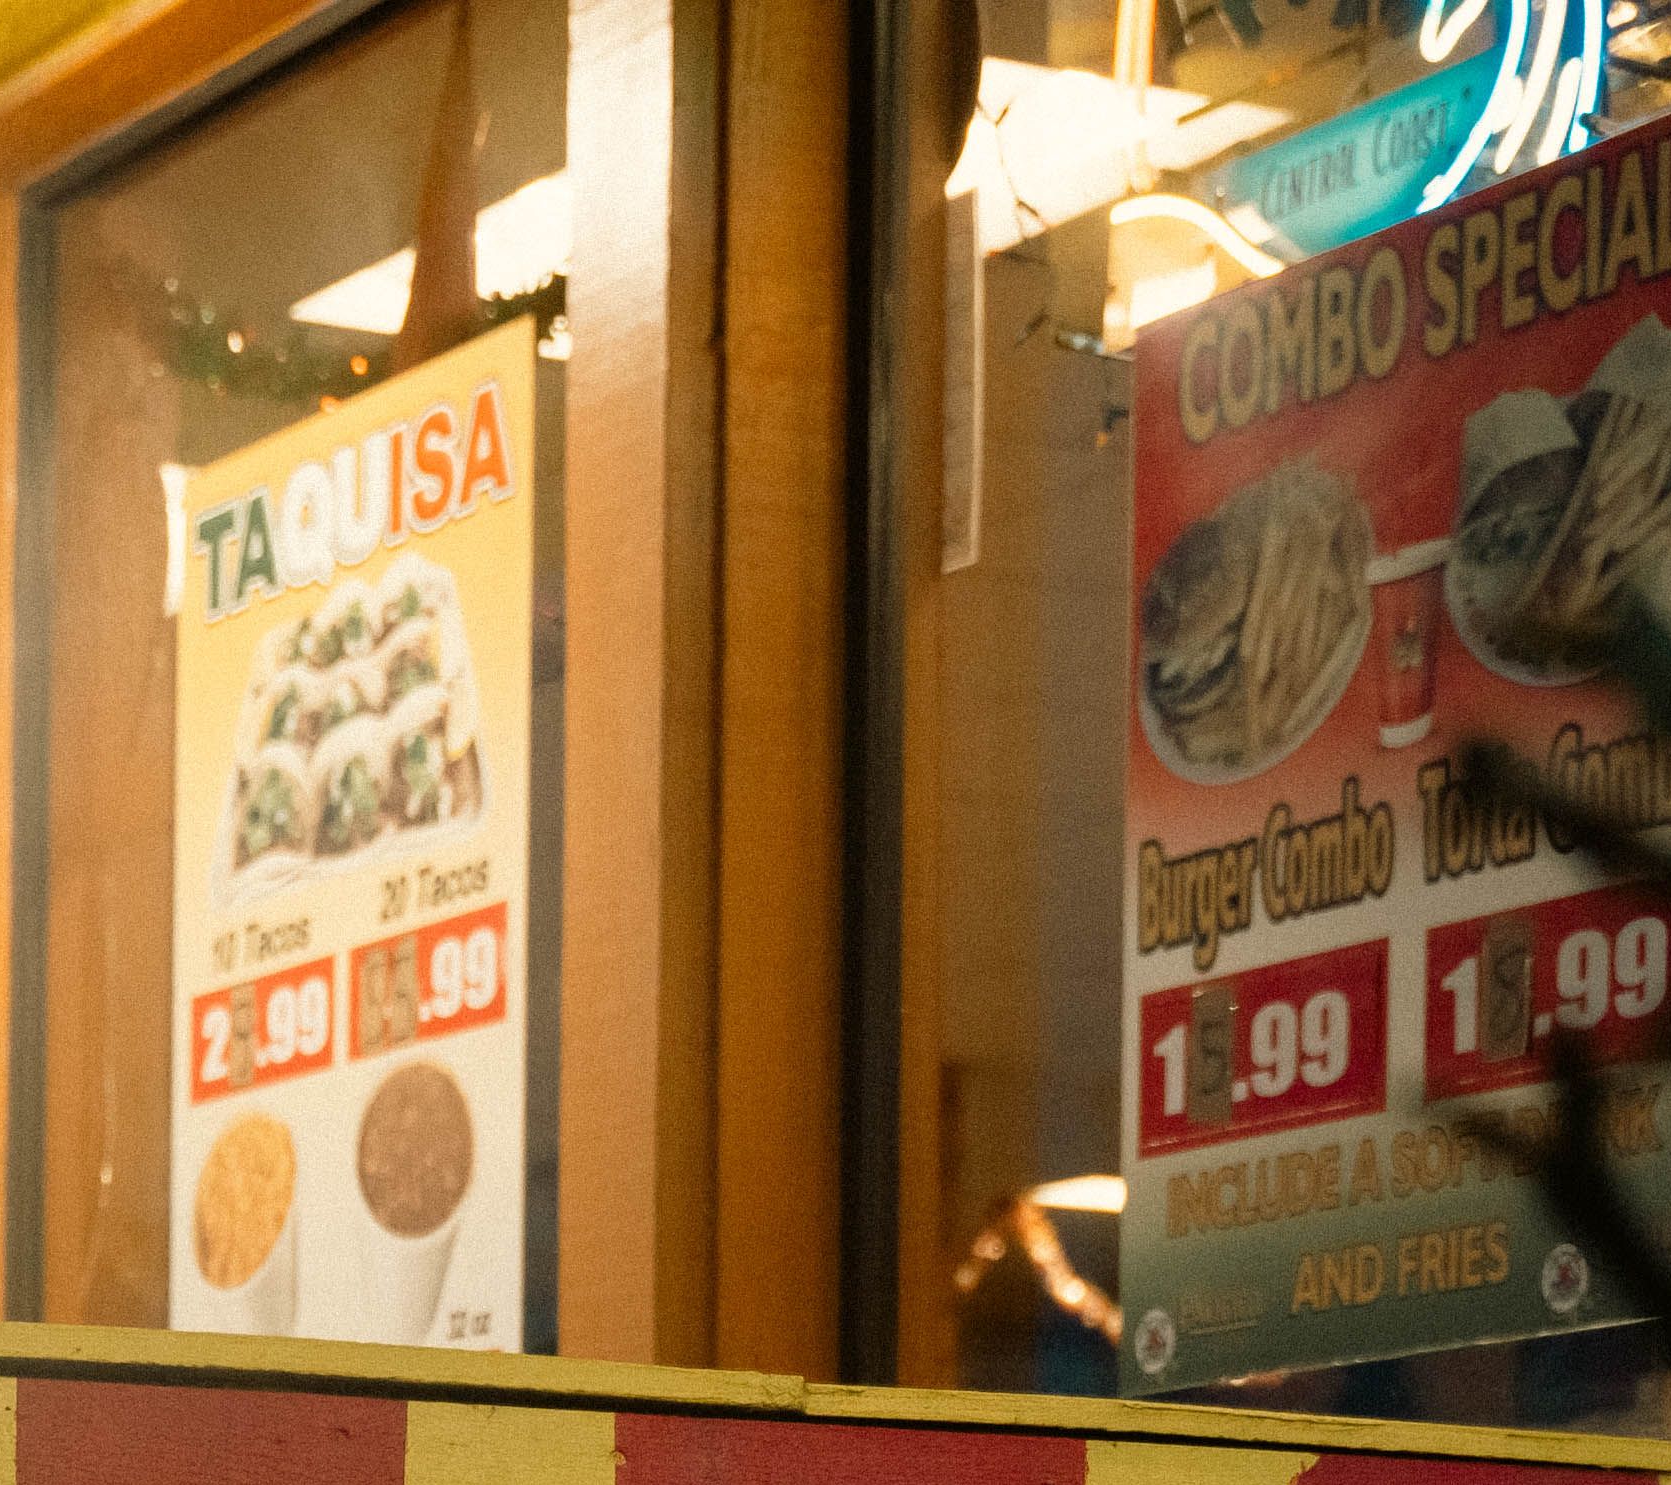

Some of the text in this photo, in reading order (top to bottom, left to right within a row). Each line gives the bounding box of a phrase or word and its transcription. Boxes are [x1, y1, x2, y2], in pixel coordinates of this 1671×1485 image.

[1178, 245, 1410, 446] COMBO
[192, 378, 517, 625] TAQUISA
[417, 858, 489, 908] Tacos
[1137, 776, 1396, 972] Burger Combo
[1166, 1142, 1342, 1240] INCLUDE
[1351, 1135, 1382, 1204] A
[1291, 1243, 1387, 1314] AND
[1397, 1220, 1512, 1296] FRIES
